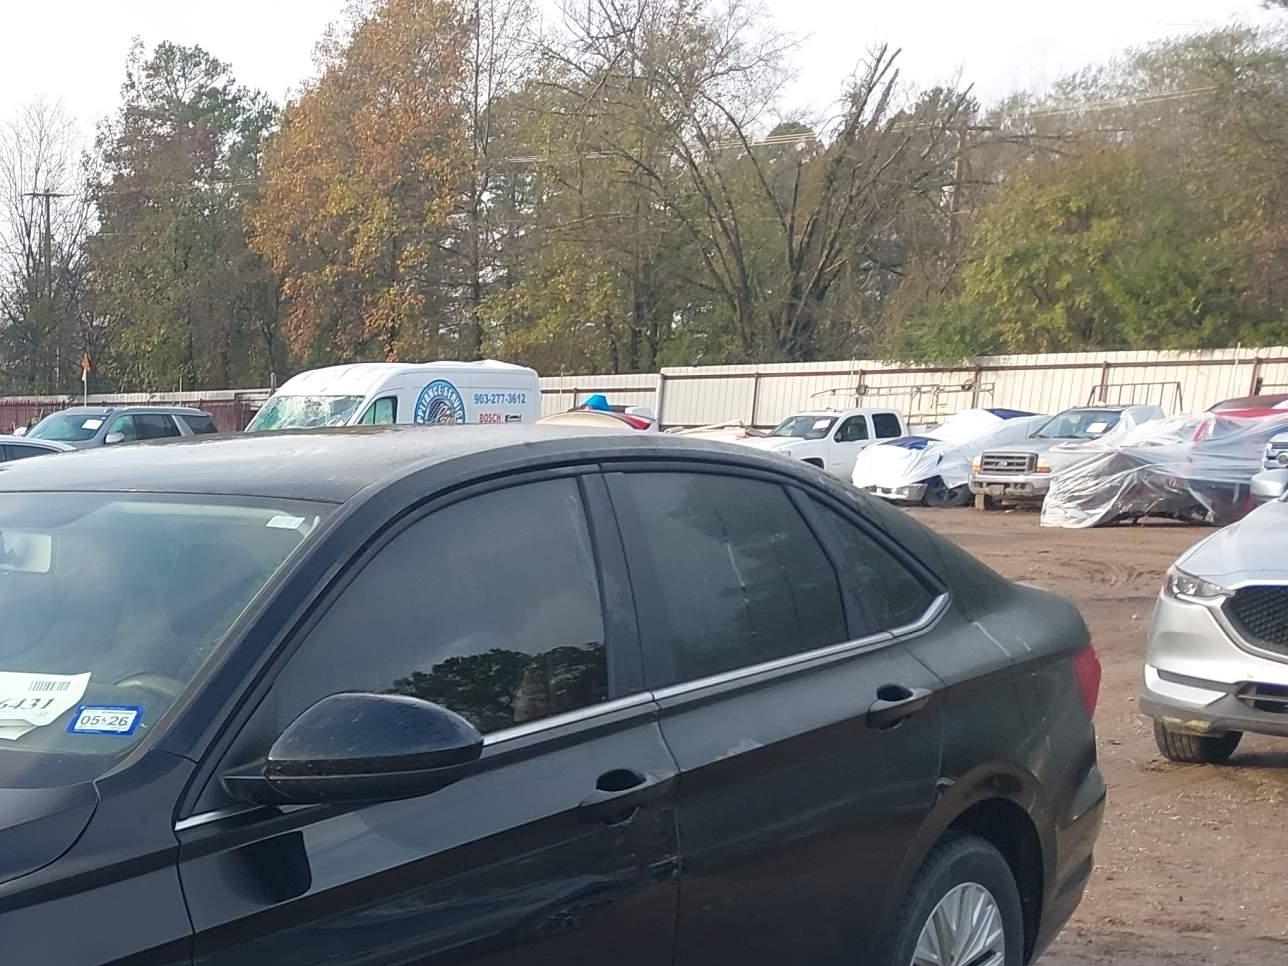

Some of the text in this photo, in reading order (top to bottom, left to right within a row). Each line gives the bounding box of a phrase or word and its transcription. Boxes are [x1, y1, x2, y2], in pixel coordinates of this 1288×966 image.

[417, 384, 442, 423] PPLIANCE
[474, 393, 526, 404] 903-277-3612
[479, 413, 502, 424] BOSCH
[80, 715, 129, 727] 05 26
